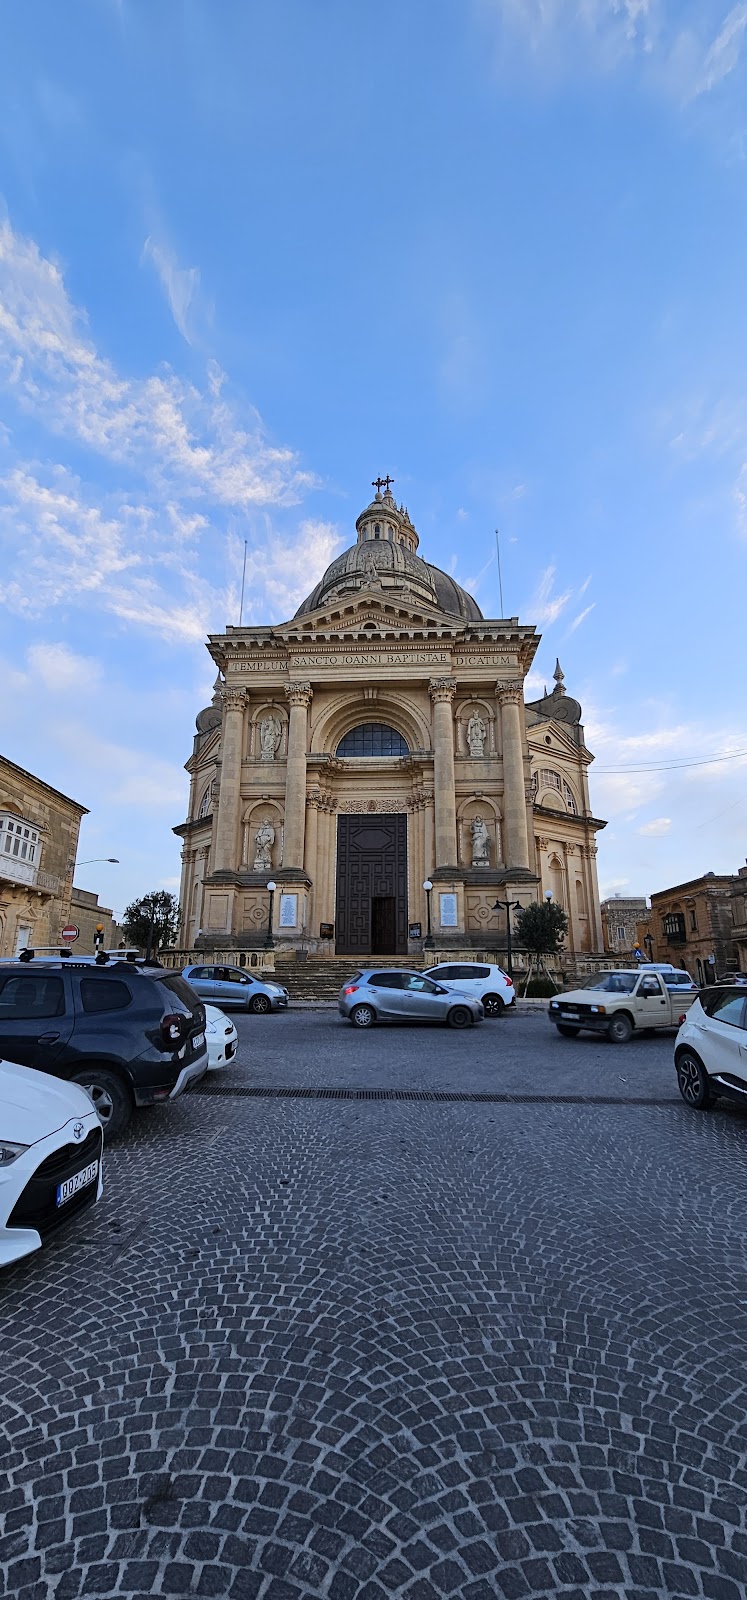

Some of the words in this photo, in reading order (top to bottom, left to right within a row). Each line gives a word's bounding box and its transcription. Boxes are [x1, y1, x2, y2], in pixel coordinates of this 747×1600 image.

[233, 661, 288, 671] TEMPLUM
[293, 656, 338, 666] SANCTO
[340, 655, 381, 665] JOANNI
[386, 653, 447, 663] BAPTISTAE
[456, 655, 510, 665] DICATUM
